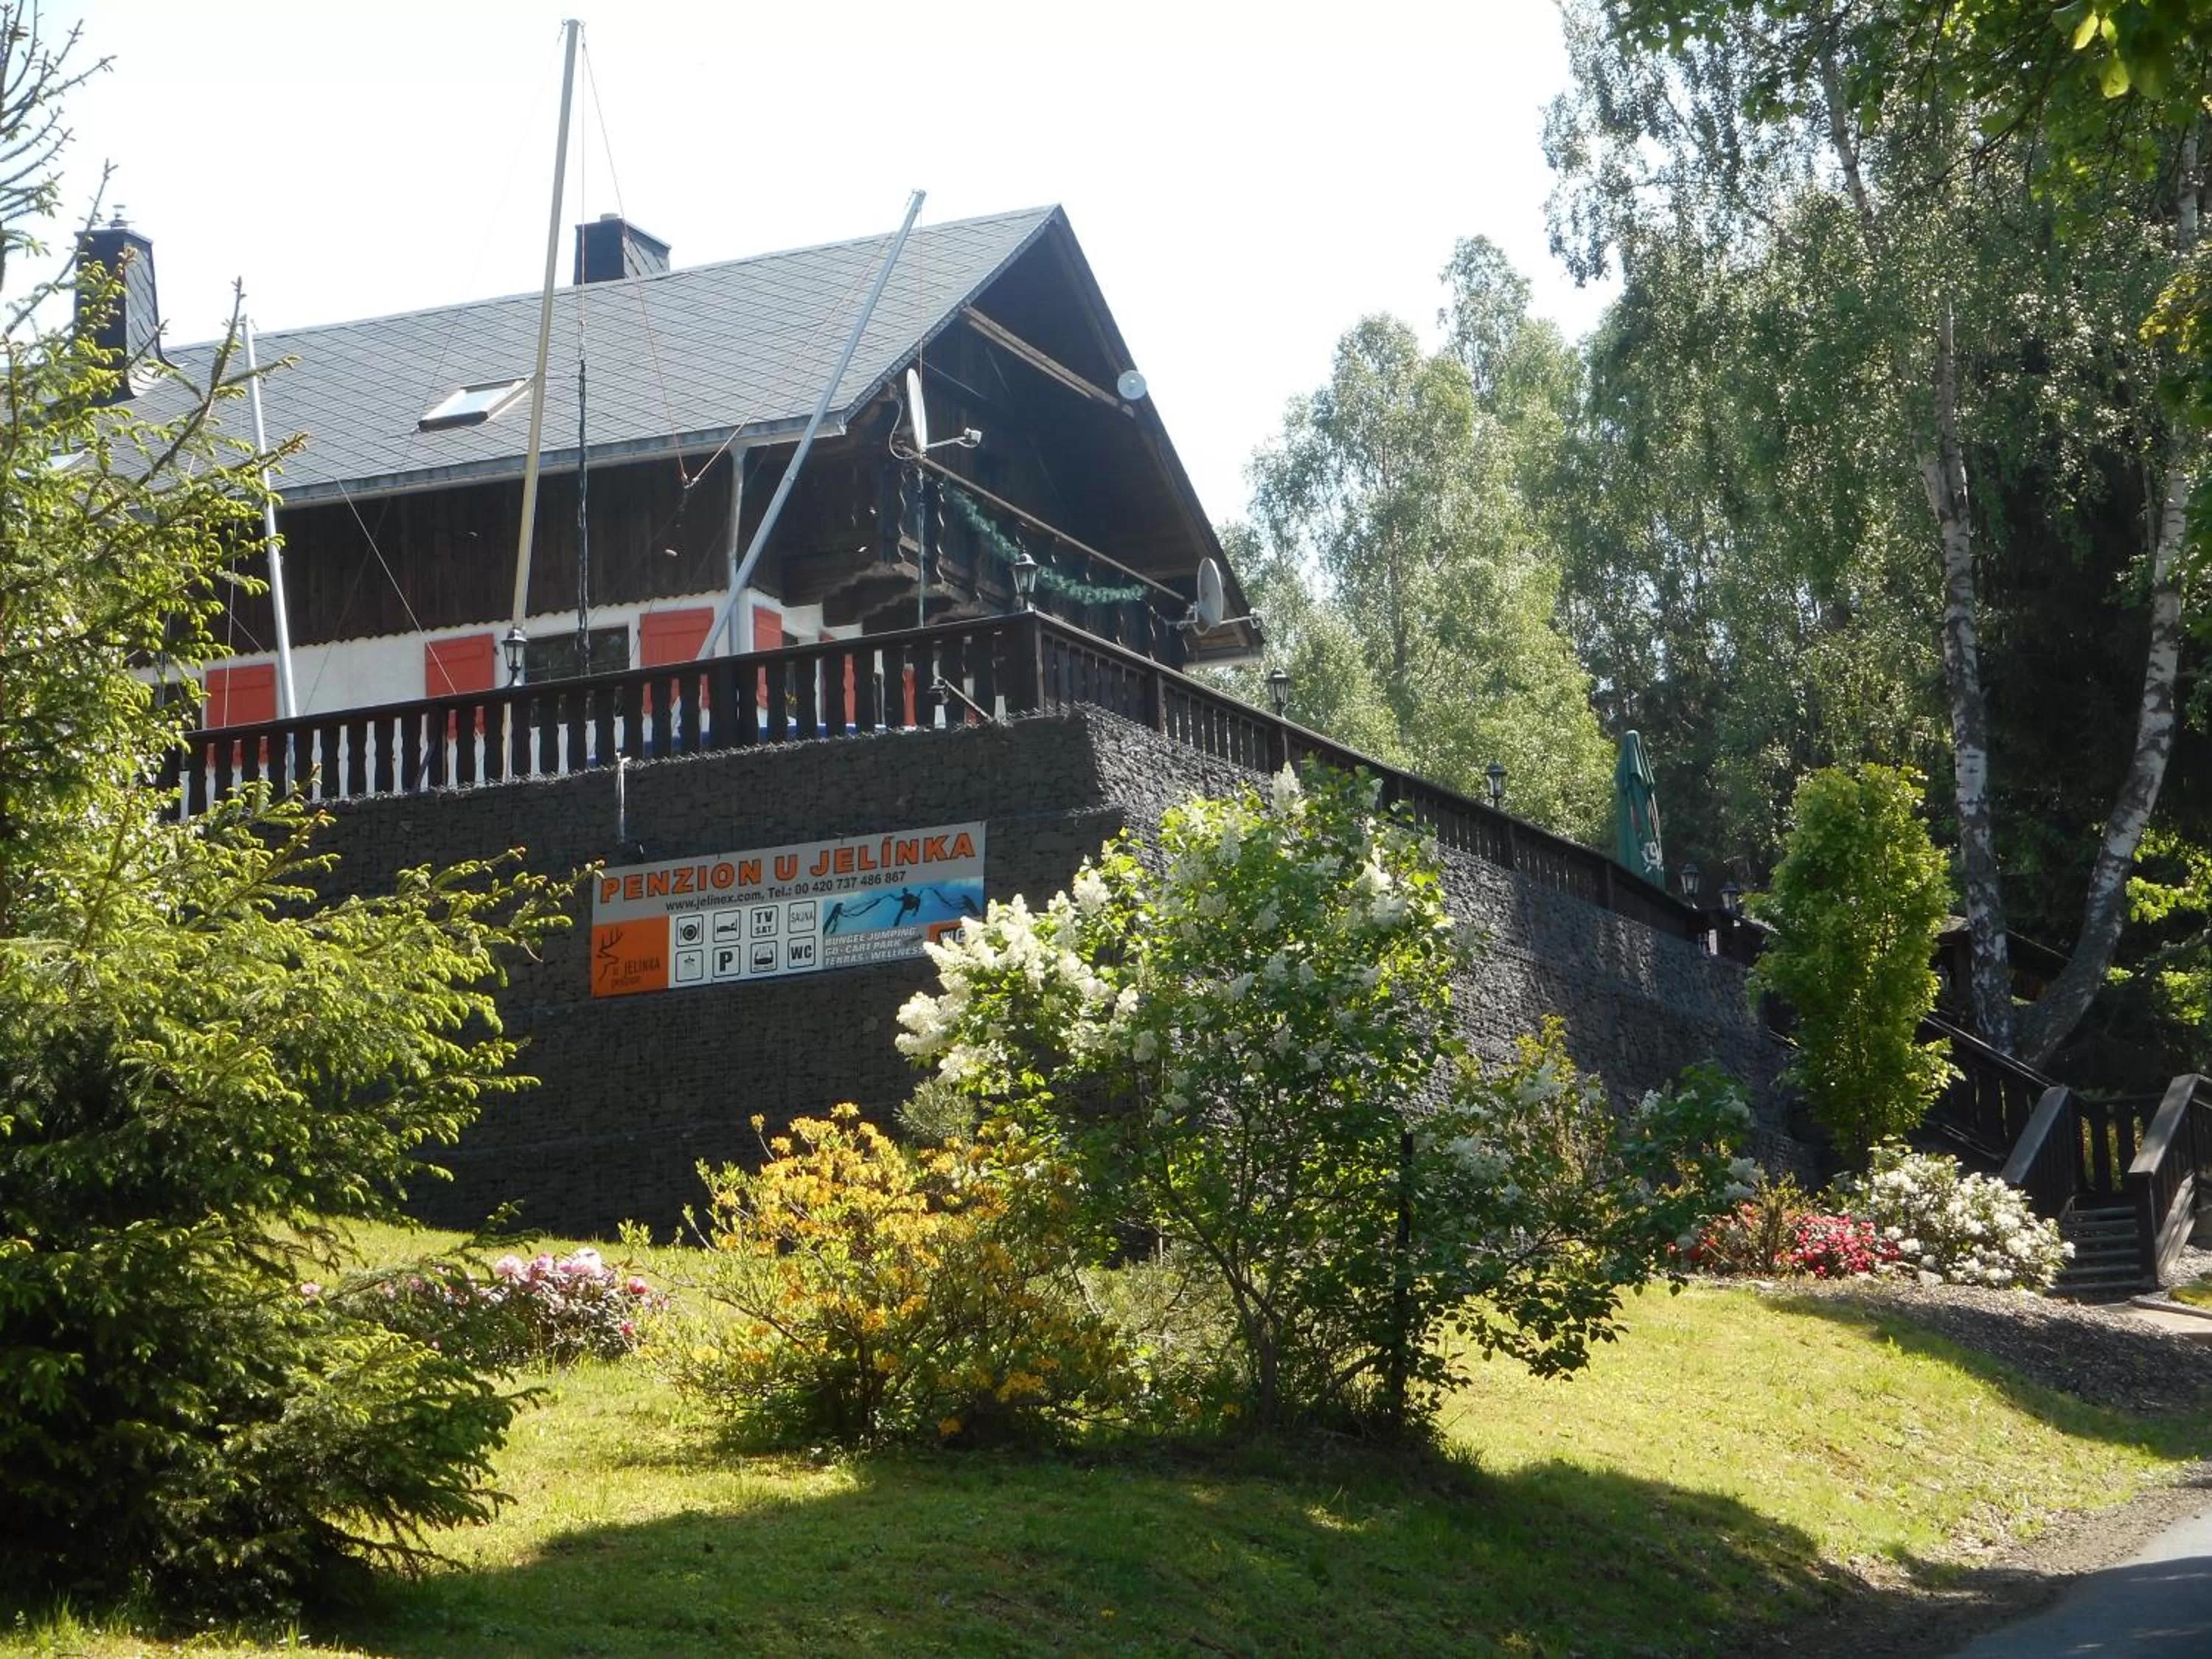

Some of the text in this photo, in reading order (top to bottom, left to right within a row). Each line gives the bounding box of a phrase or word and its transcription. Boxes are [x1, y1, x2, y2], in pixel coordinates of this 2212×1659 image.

[599, 832, 975, 904] PENZION U JELÍNKA
[795, 883, 809, 895] 00
[812, 879, 833, 892] 420
[837, 875, 858, 890] 737
[860, 873, 882, 886] 486
[754, 911, 773, 924] TV
[755, 925, 773, 935] SAT
[719, 950, 734, 973] P
[790, 945, 813, 961] WC
